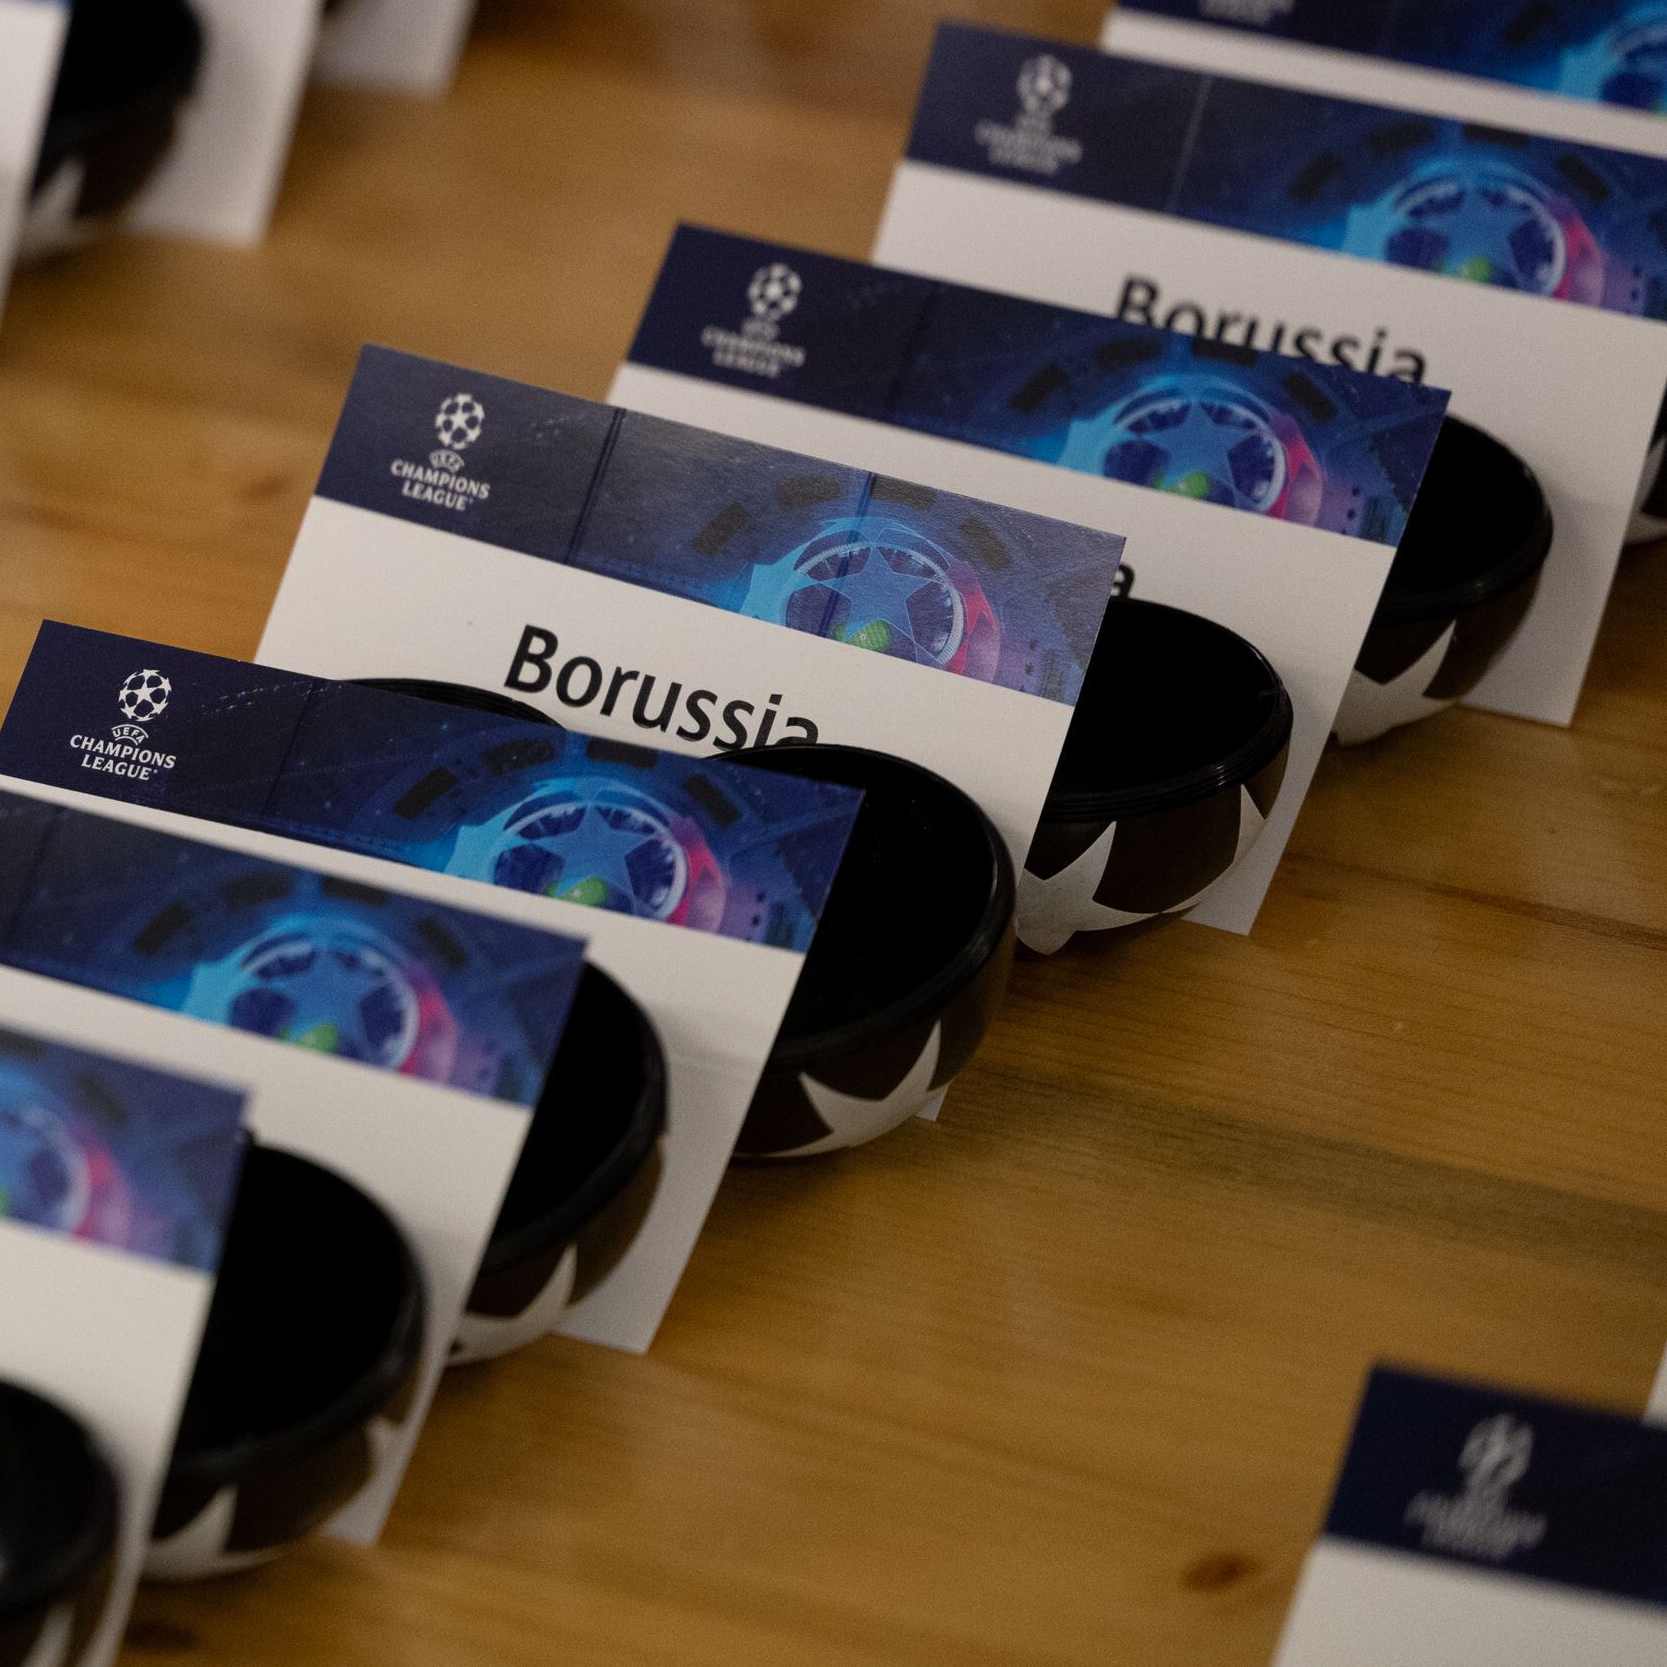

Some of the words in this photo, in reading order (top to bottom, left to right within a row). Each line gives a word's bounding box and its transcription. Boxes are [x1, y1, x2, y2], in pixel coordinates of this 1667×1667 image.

[390, 459, 491, 500] CHAMPIONS
[402, 480, 467, 512] LEAGUE
[69, 734, 177, 770] CHAMPIONS
[111, 726, 147, 746] UEFA
[81, 753, 152, 781] LEAGUE
